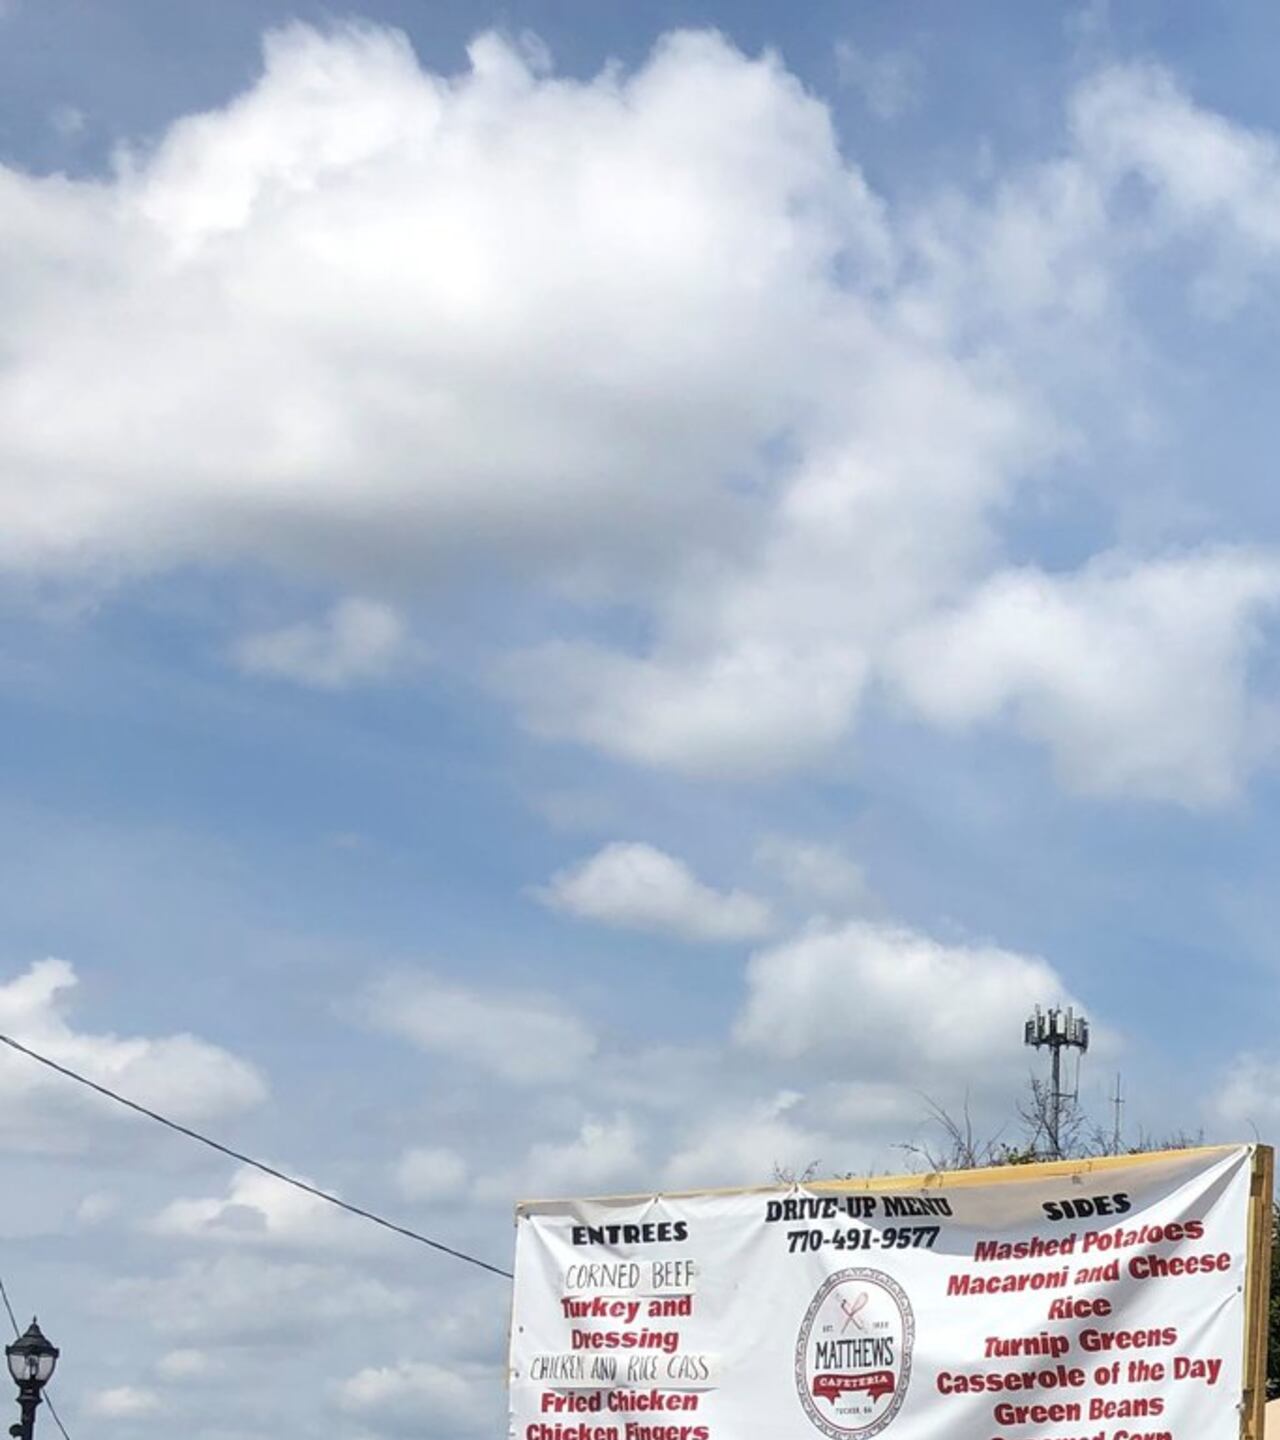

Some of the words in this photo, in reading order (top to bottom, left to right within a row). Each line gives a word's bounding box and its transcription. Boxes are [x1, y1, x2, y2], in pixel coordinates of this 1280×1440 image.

[765, 1196, 877, 1222] DRIVE-UP
[881, 1195, 954, 1217] MENU
[1042, 1193, 1132, 1221] SIDES
[572, 1221, 688, 1245] ENTREES
[787, 1226, 941, 1253] 770-491-9577
[974, 1233, 1076, 1262] Mashed
[1082, 1219, 1205, 1254] Potatoes
[565, 1263, 641, 1289] CORNED
[652, 1260, 695, 1288] BEEF
[946, 1266, 1069, 1296] Macaroni
[1074, 1259, 1120, 1285] and
[1128, 1252, 1231, 1280] Cheese
[561, 1297, 641, 1324] Turkey
[648, 1295, 692, 1317] and
[1048, 1297, 1112, 1320] Rice
[571, 1328, 679, 1353] Dressing
[815, 1336, 894, 1370] MATTHEWS
[984, 1331, 1070, 1358] Turnip
[1079, 1326, 1178, 1352] Greens
[590, 1356, 617, 1381] AND
[666, 1355, 709, 1380] CASS
[819, 1375, 888, 1388] CAFETERIA
[936, 1364, 1086, 1395] Casserole
[1094, 1360, 1121, 1382] of
[1128, 1359, 1165, 1382] the
[1173, 1356, 1222, 1385] Day
[541, 1391, 600, 1413] Fried
[607, 1388, 699, 1412] Chicken
[993, 1402, 1082, 1426] Green
[1088, 1396, 1165, 1420] Beans
